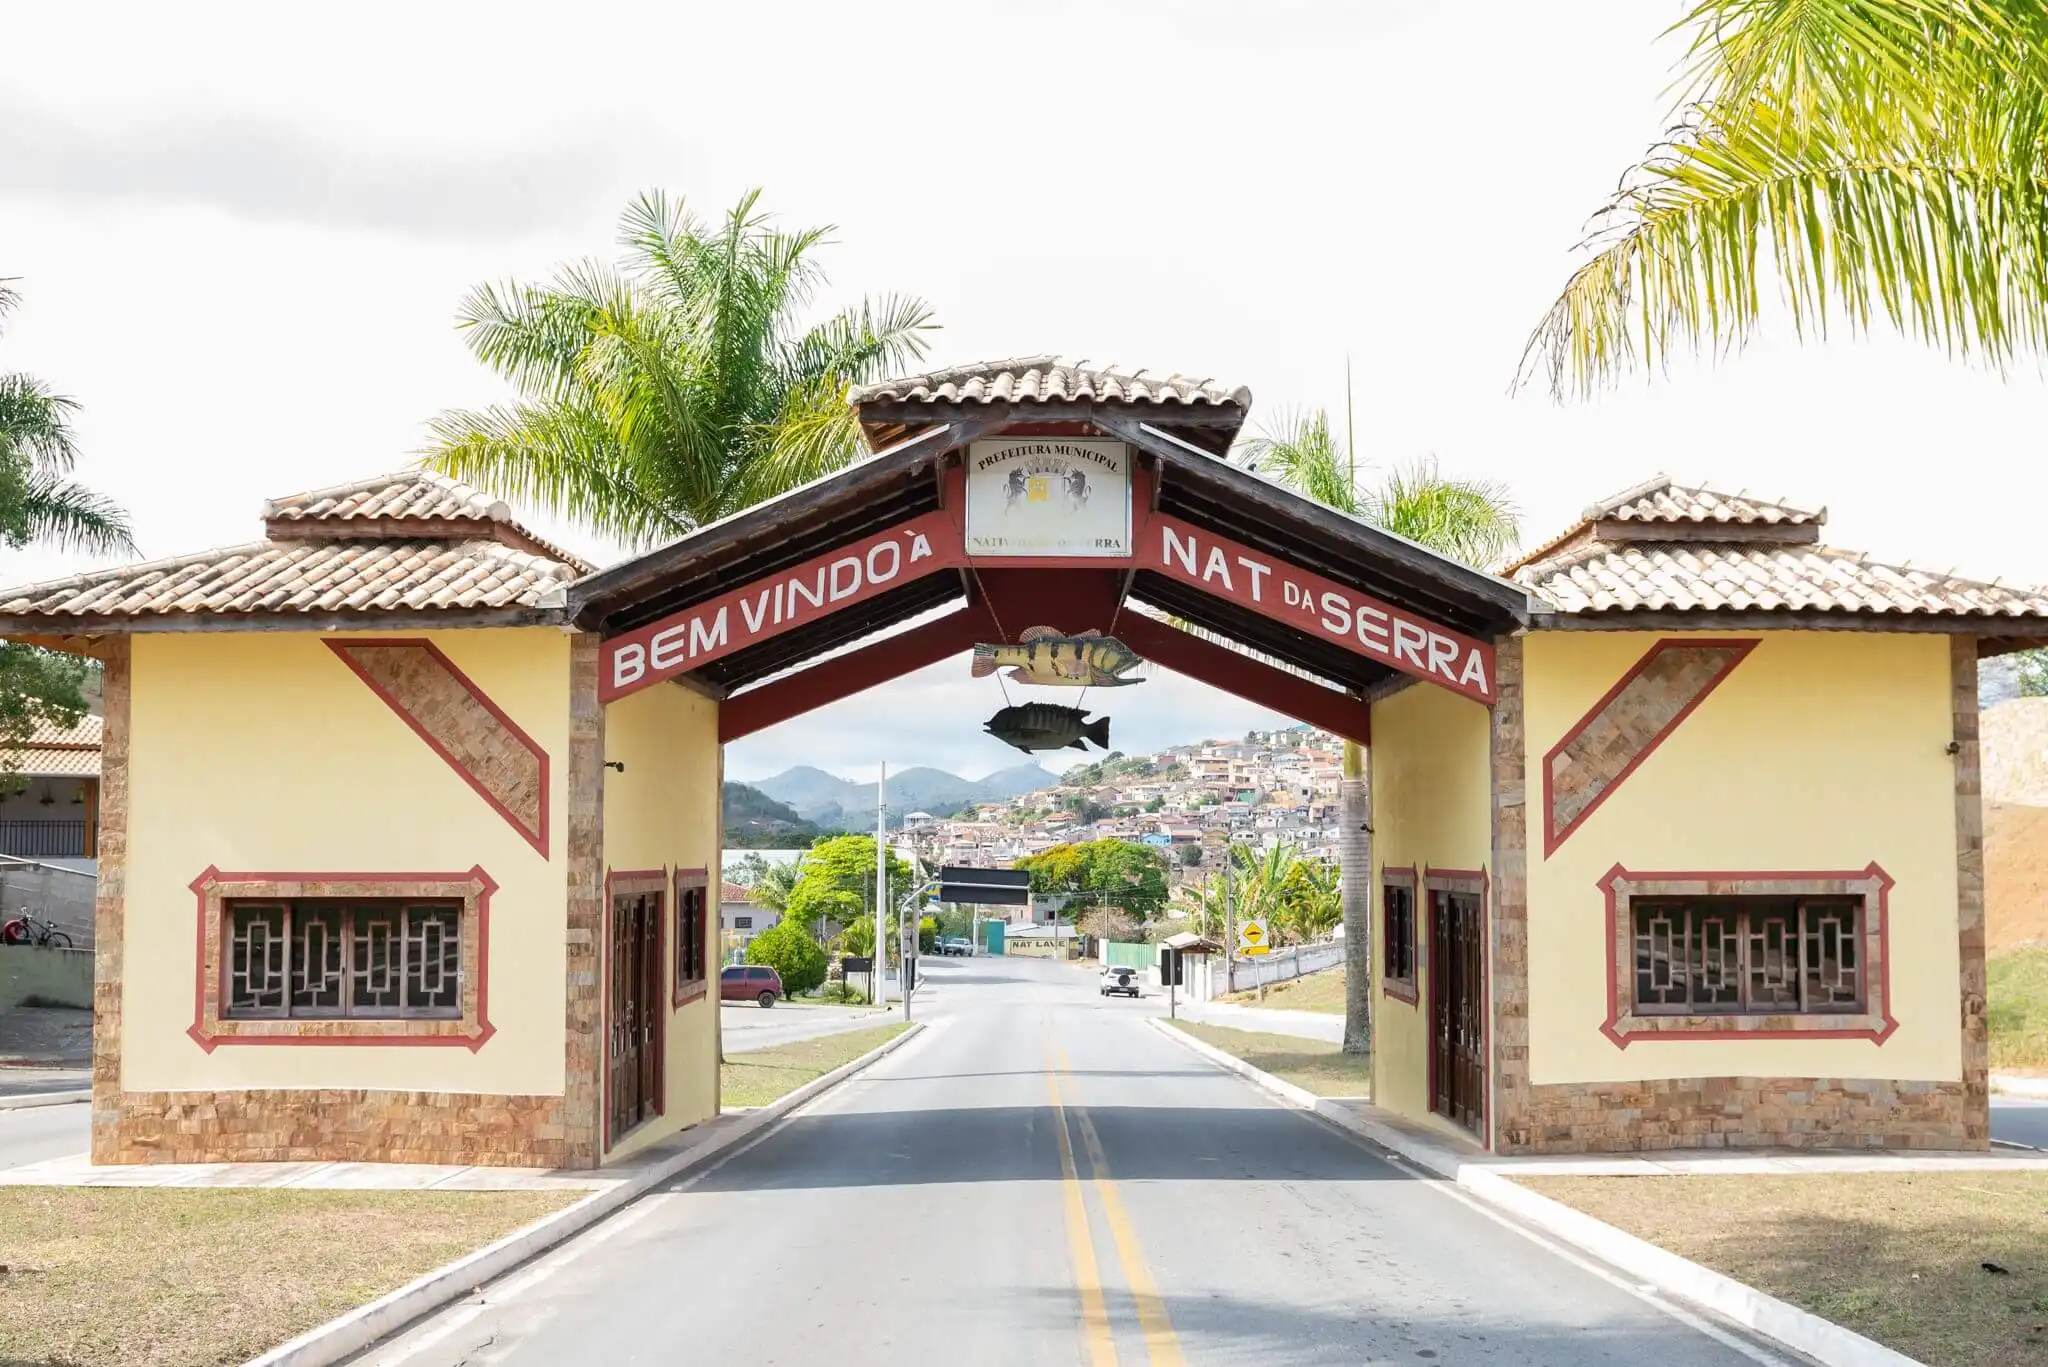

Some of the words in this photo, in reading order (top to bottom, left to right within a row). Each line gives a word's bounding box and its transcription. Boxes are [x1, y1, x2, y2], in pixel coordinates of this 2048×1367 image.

[977, 445, 1051, 470] PREFEITURA
[1054, 445, 1118, 473] MUNICIPAL
[613, 606, 728, 688] BEM
[739, 540, 900, 634] VINDO
[904, 529, 933, 563] À
[1162, 526, 1271, 602] NAT
[1283, 580, 1316, 615] DA
[1321, 591, 1489, 695] SERRA
